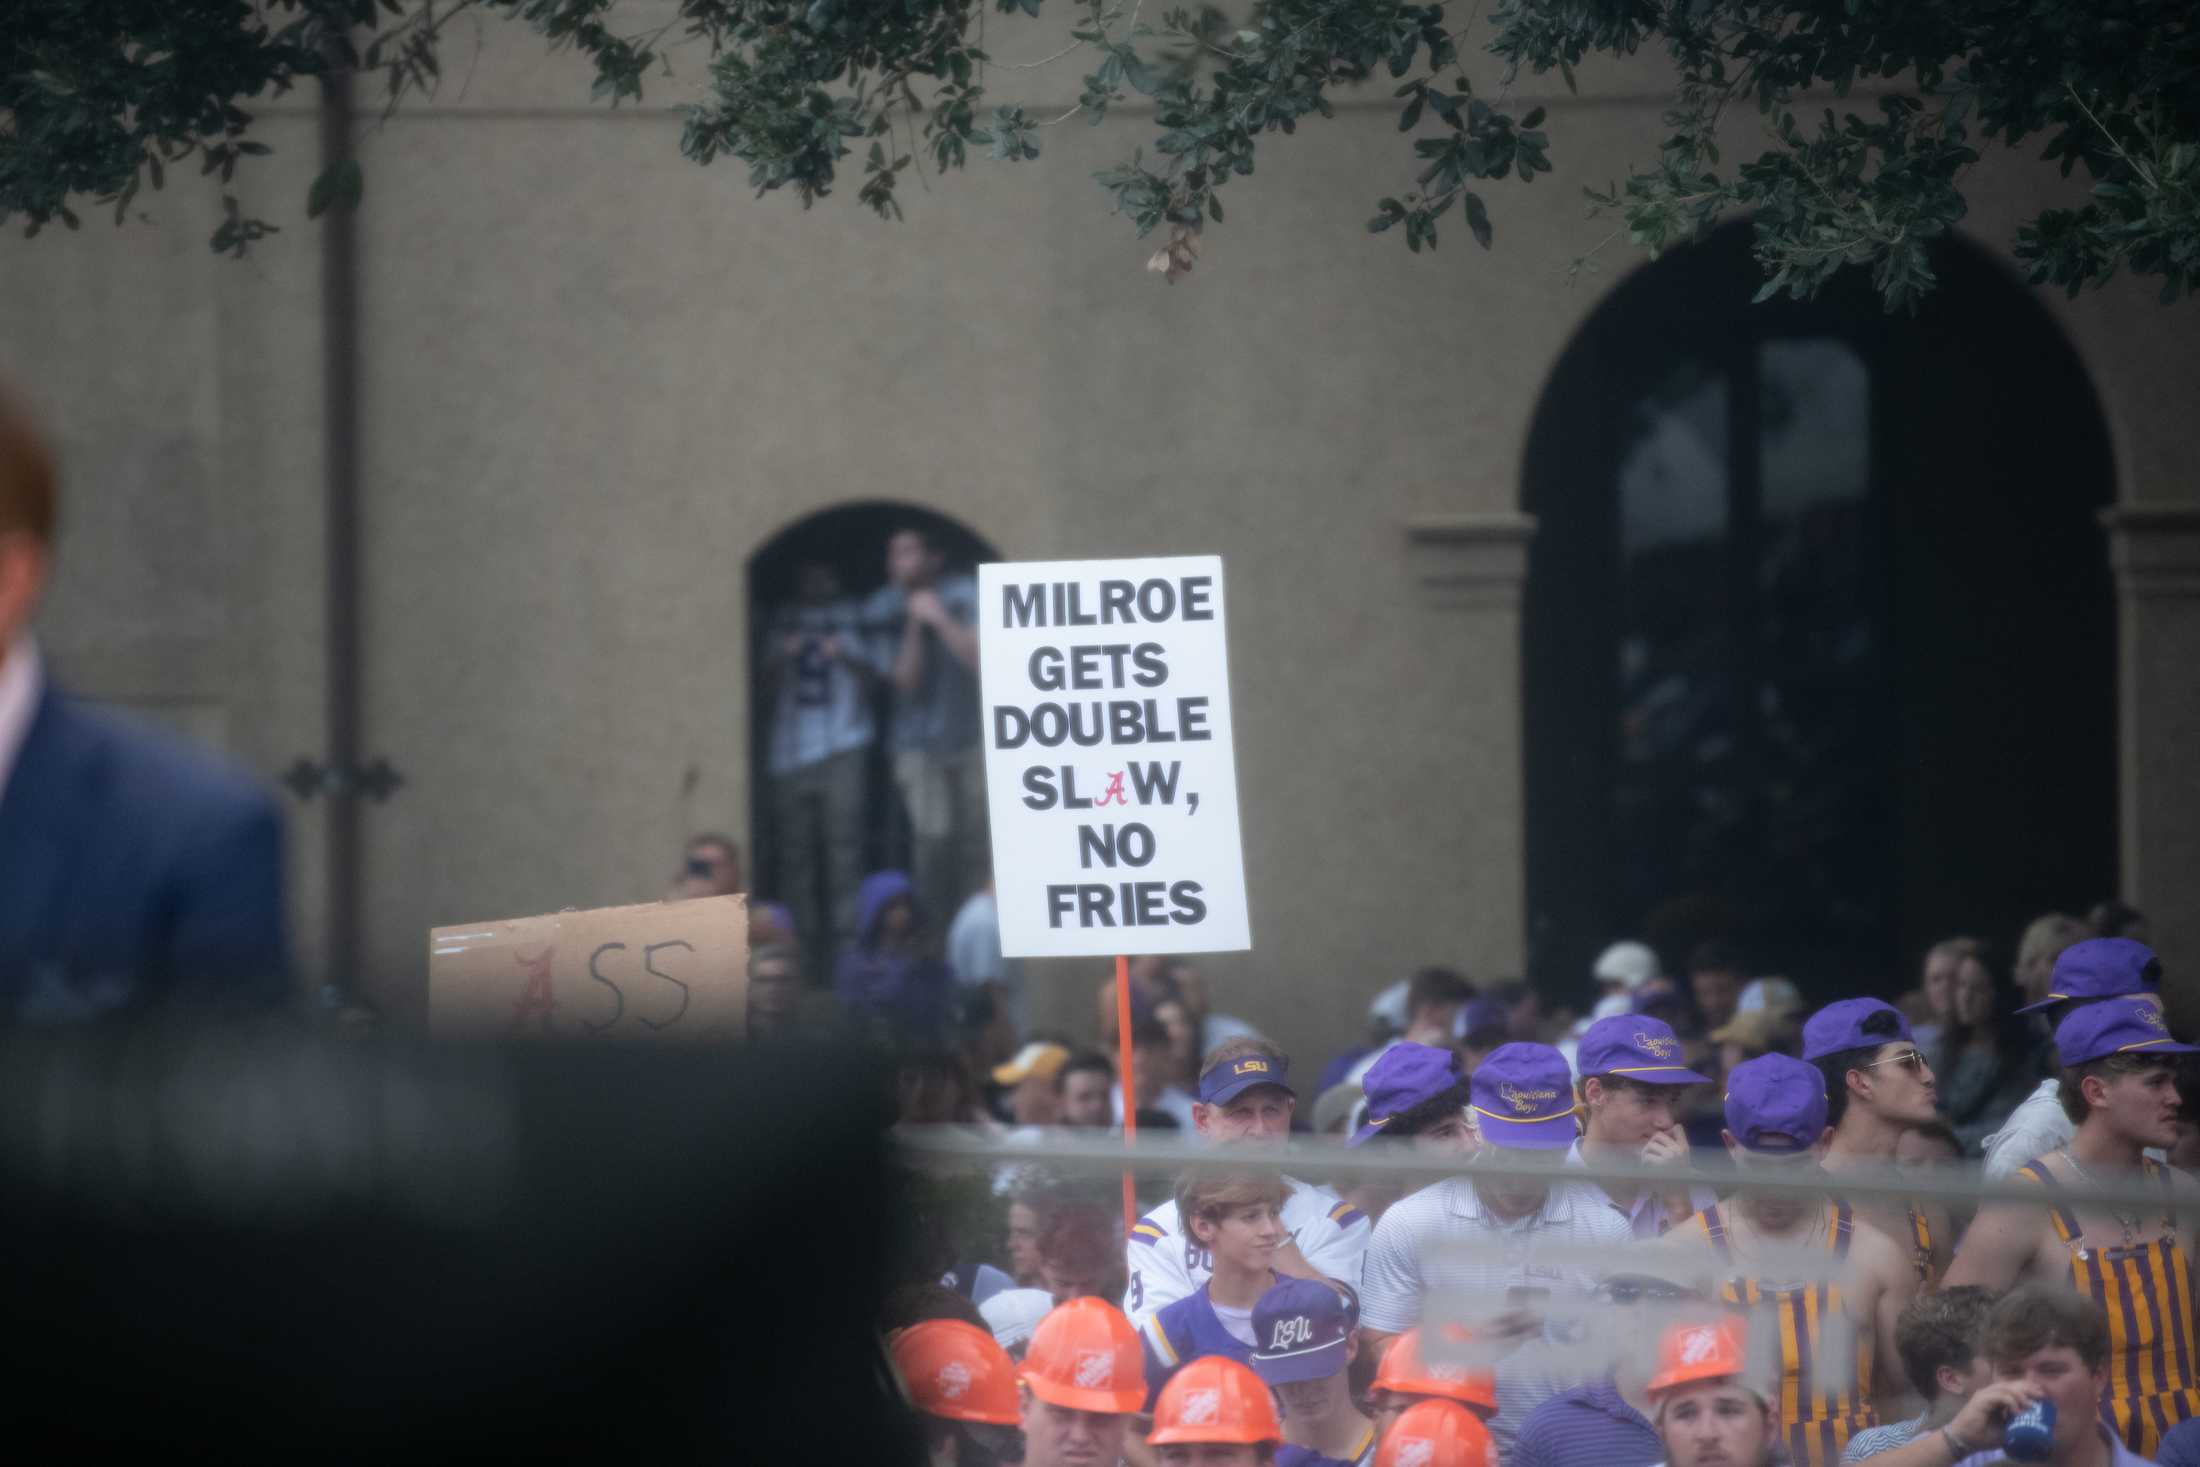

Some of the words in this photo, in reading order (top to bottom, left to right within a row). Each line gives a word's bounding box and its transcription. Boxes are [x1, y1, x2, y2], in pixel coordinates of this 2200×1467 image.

[1002, 576, 1214, 628] MILROE
[1028, 642, 1169, 691] GETS
[993, 697, 1212, 749] DOUBLE
[1022, 761, 1199, 815] SLAW,
[1078, 822, 1156, 869] NO
[1046, 880, 1207, 928] FRIES
[513, 940, 696, 1031] ASS
[1234, 1061, 1268, 1075] LSU
[1269, 1315, 1312, 1350] LSU
